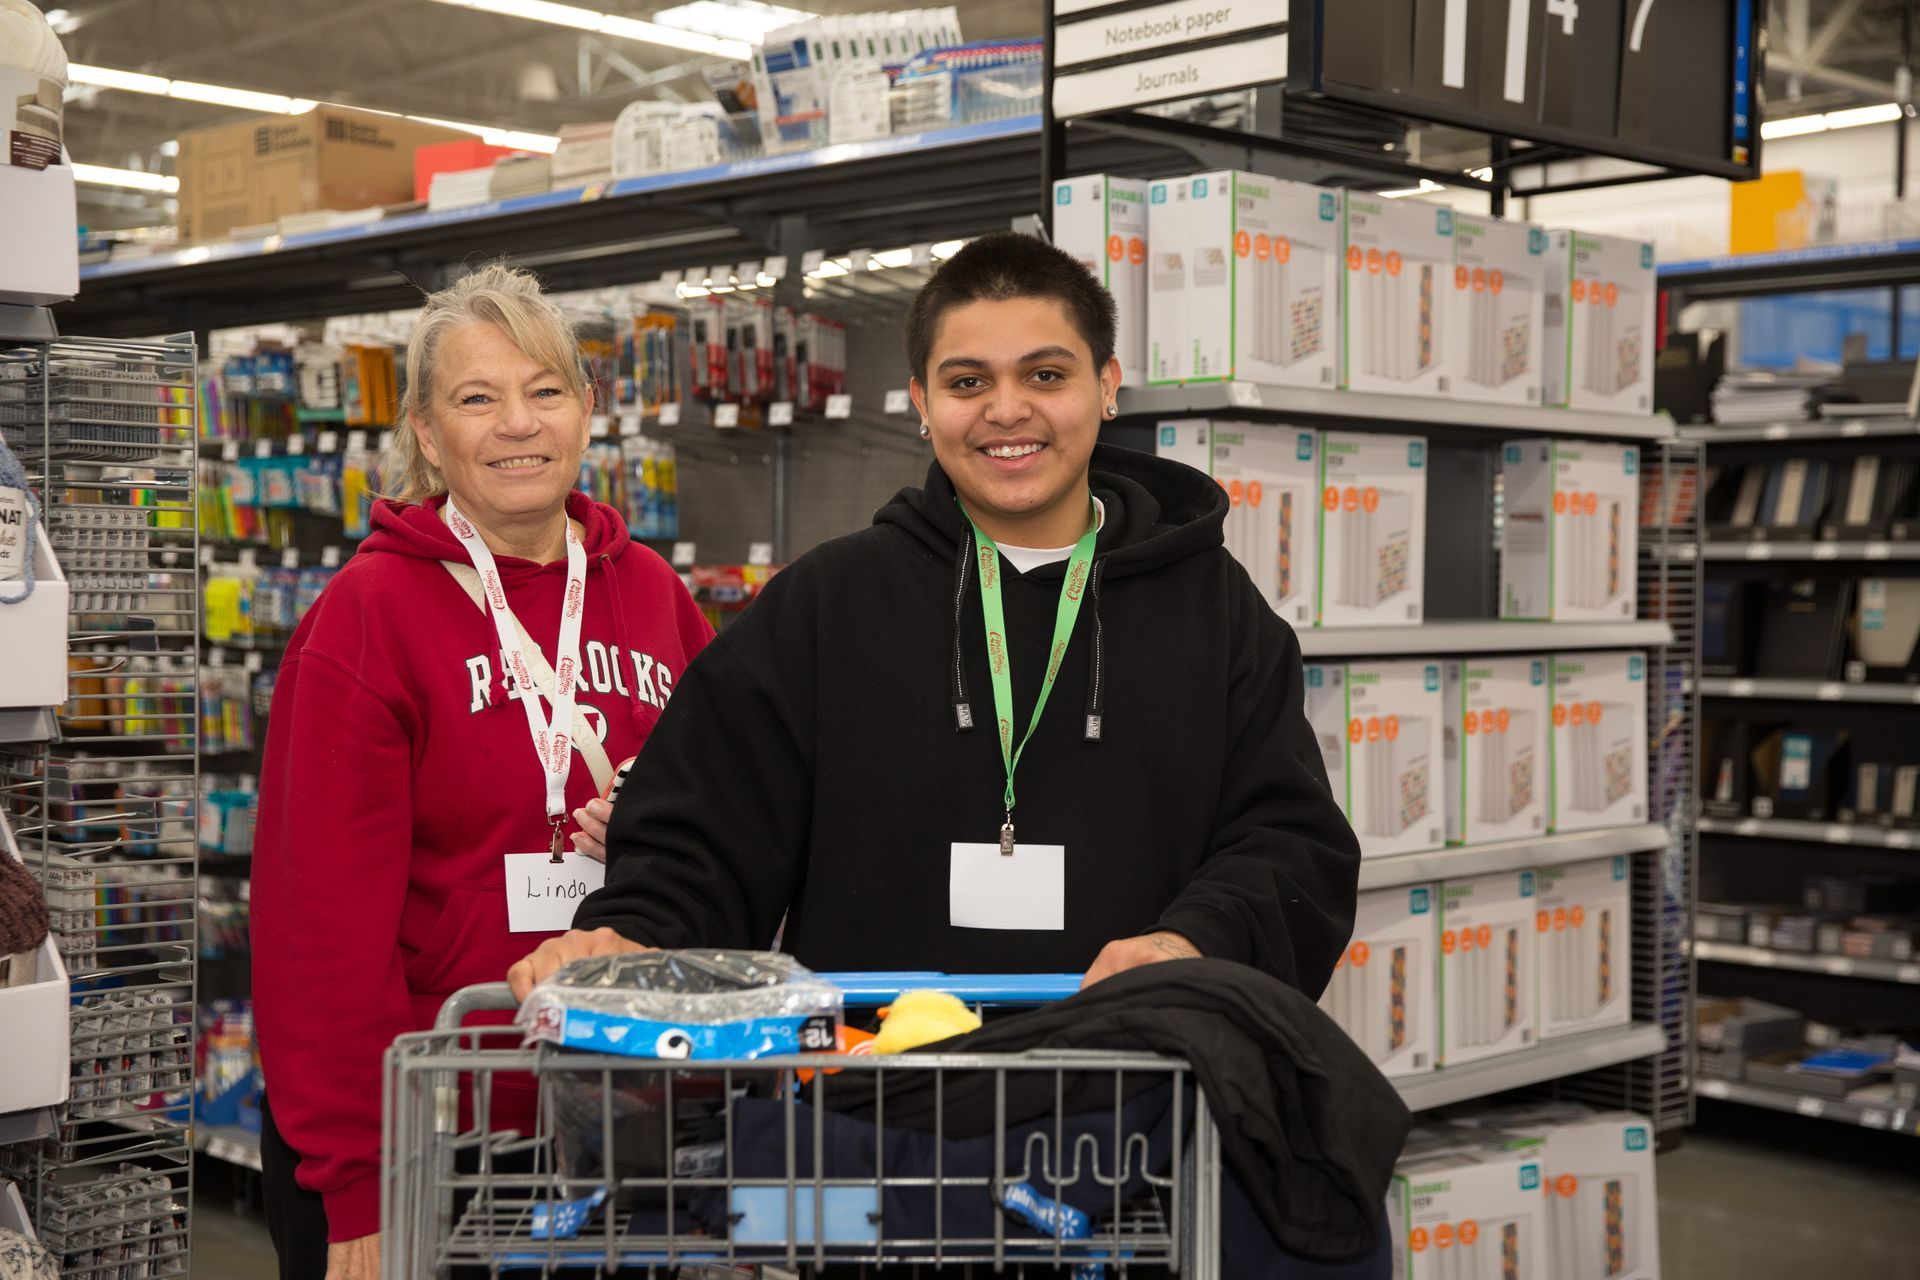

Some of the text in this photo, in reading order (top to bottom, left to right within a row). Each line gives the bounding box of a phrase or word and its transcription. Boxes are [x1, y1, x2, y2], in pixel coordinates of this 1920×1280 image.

[1105, 8, 1232, 45] Notebook paper
[1135, 64, 1199, 92] Journals
[527, 876, 587, 899] Linda
[804, 1027, 834, 1048] 12
